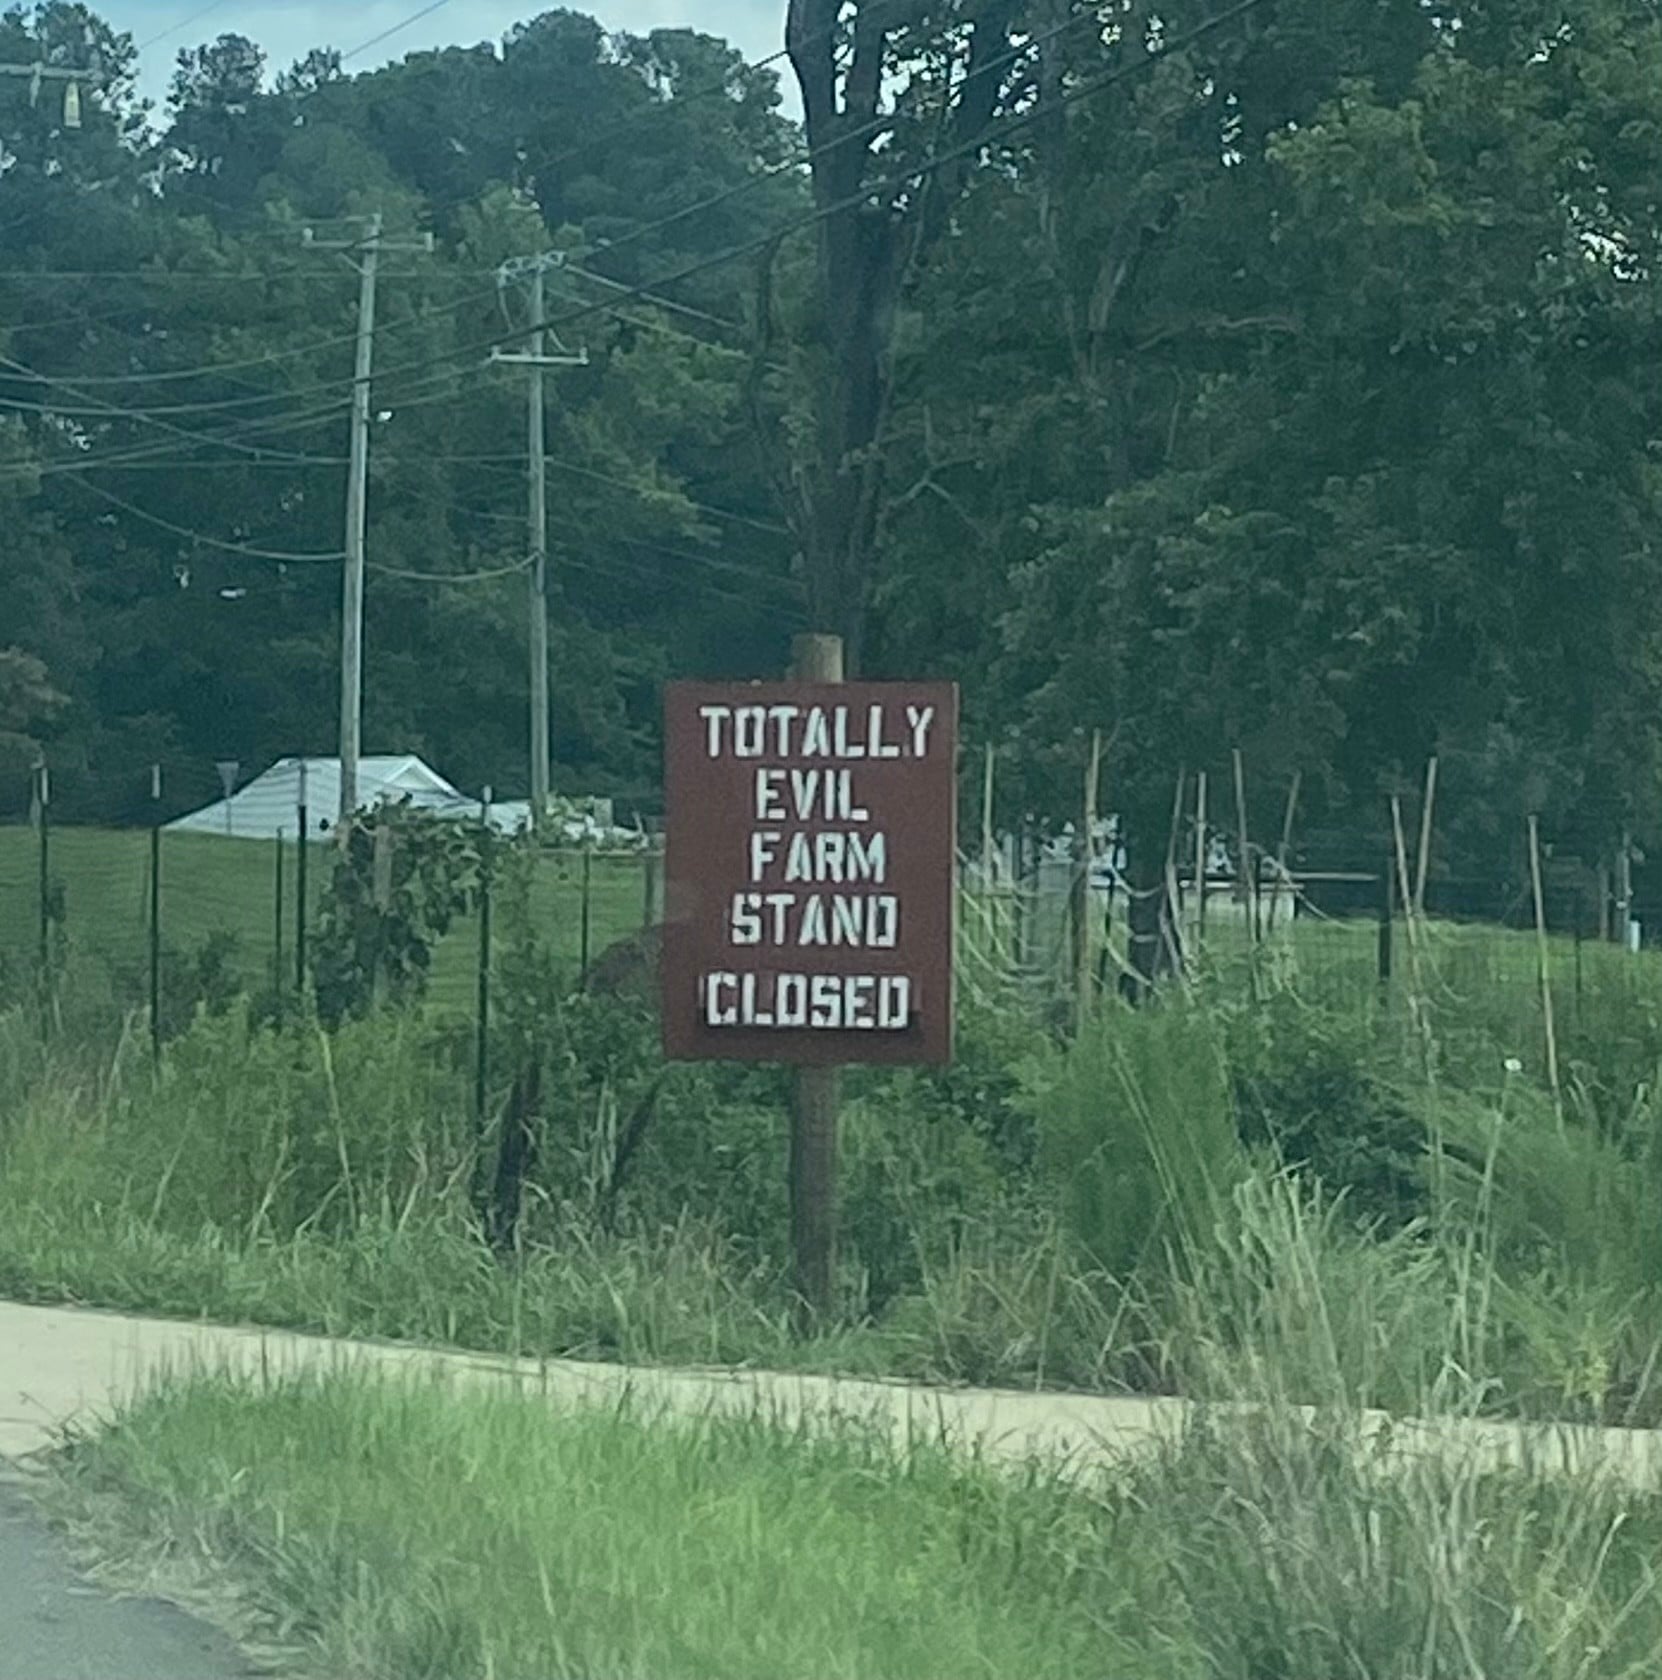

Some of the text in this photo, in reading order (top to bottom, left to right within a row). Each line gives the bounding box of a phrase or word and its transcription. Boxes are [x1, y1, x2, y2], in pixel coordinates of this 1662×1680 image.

[700, 705, 934, 758] TOTALLY
[756, 768, 869, 821] EVIL
[751, 831, 886, 883] FARM
[732, 893, 898, 948] STAND
[707, 972, 910, 1029] CLOSED
